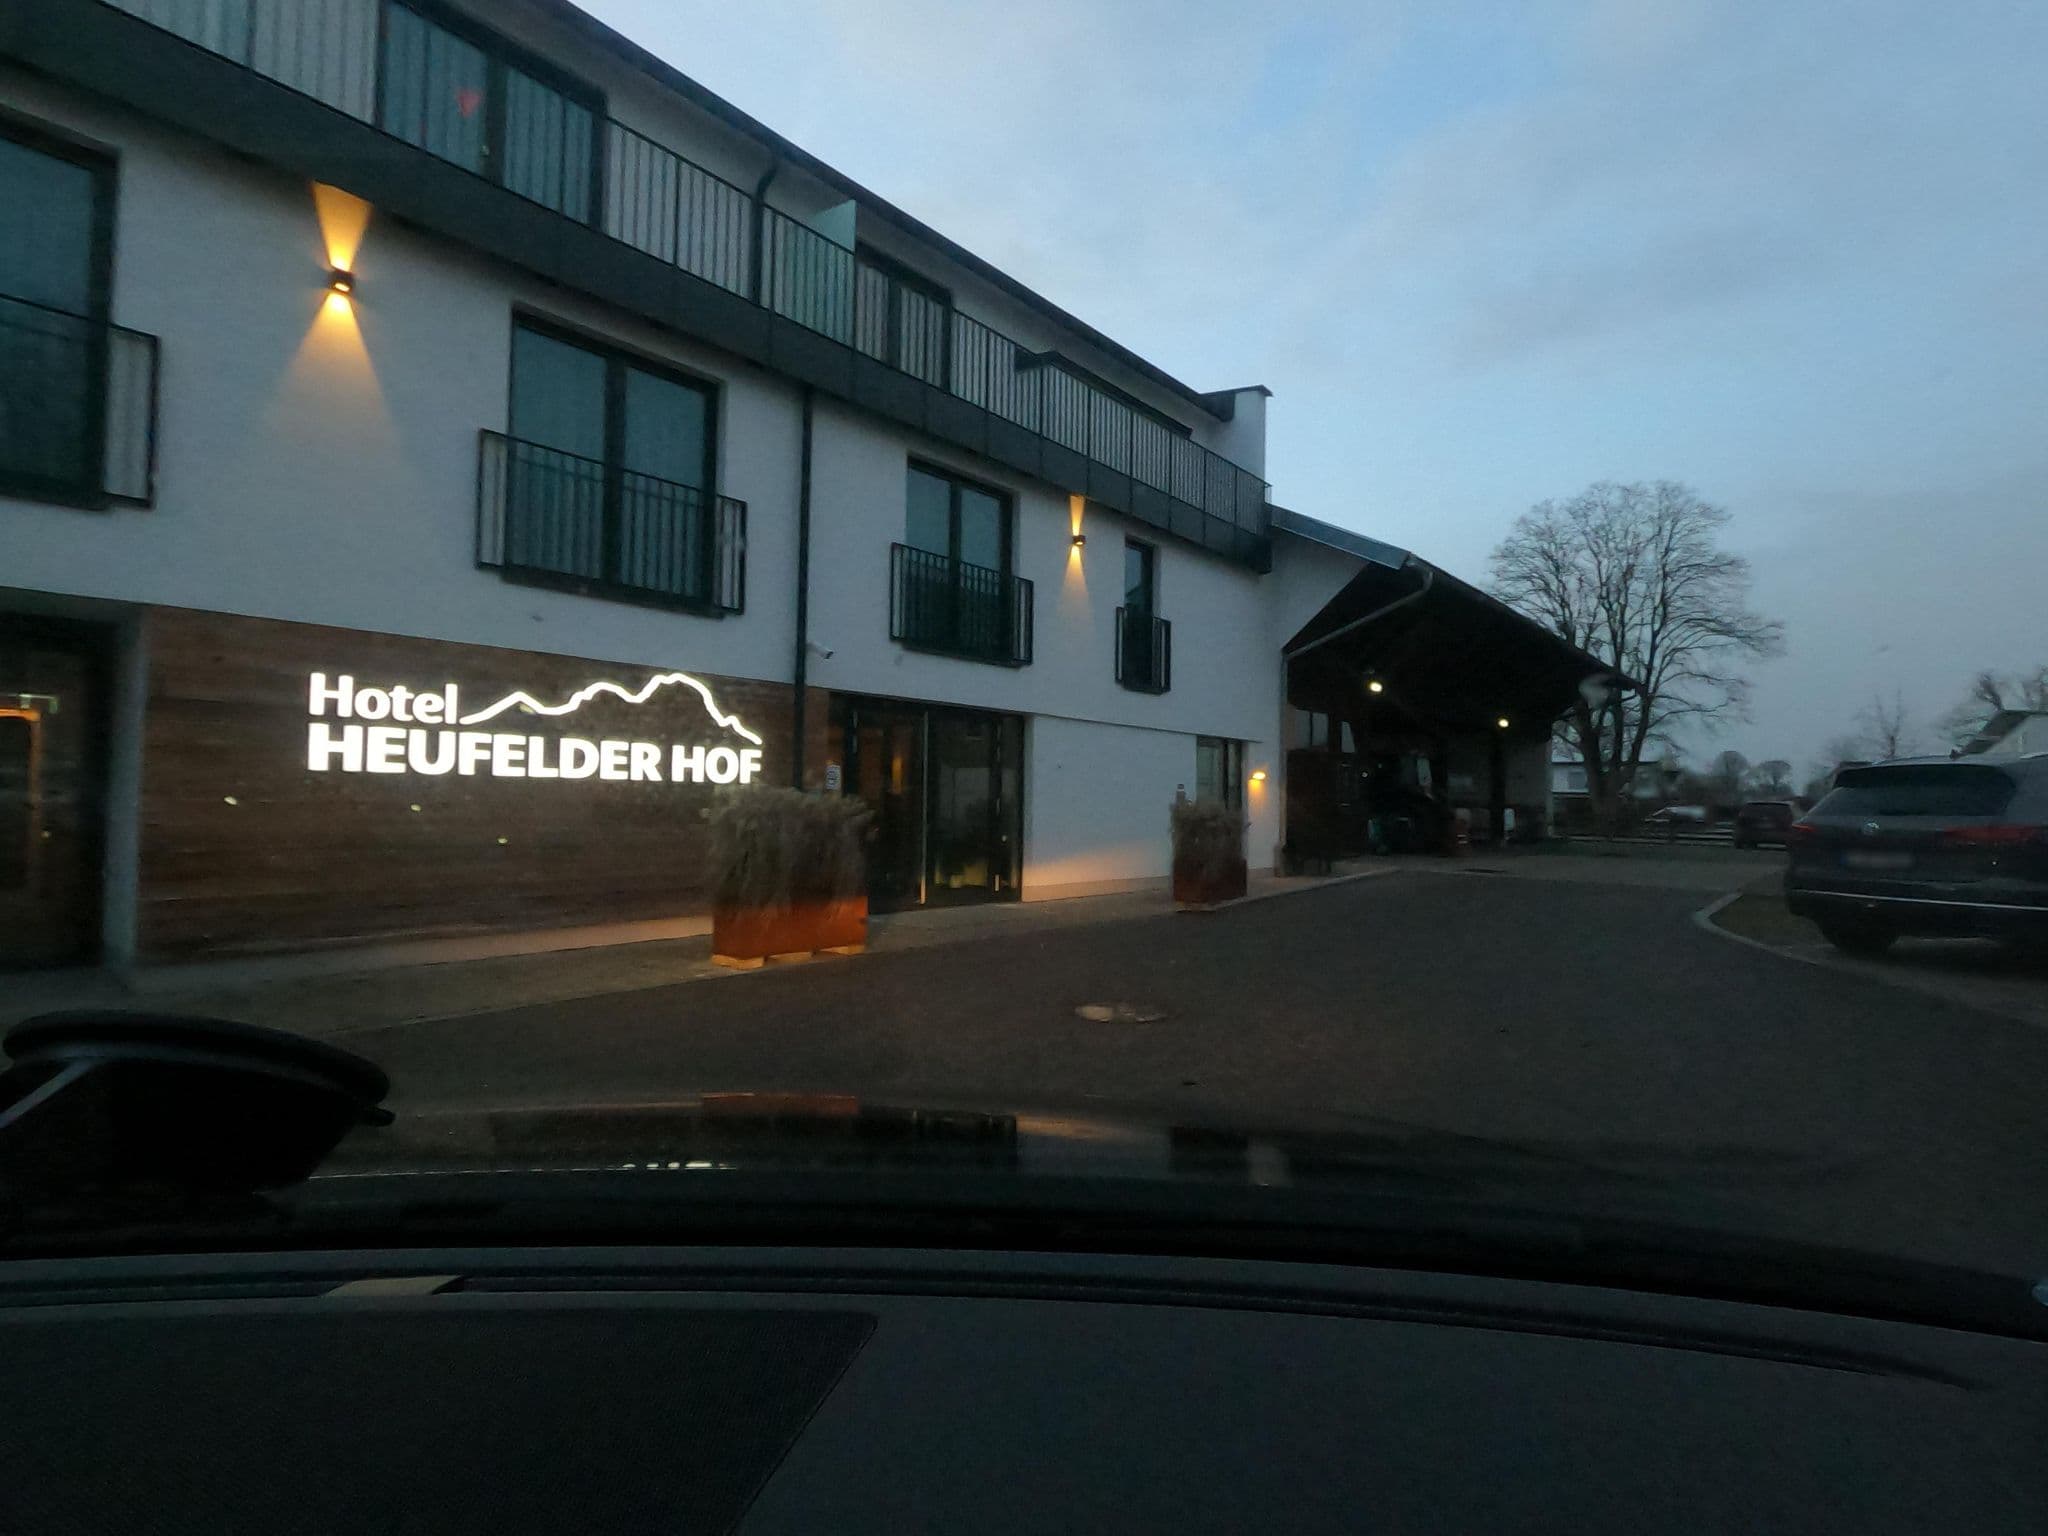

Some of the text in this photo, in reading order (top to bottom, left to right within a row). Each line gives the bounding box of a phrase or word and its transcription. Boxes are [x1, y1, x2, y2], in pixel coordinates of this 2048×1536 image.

[308, 672, 458, 724] Hotel
[307, 723, 763, 784] HEUFELDER HOF
